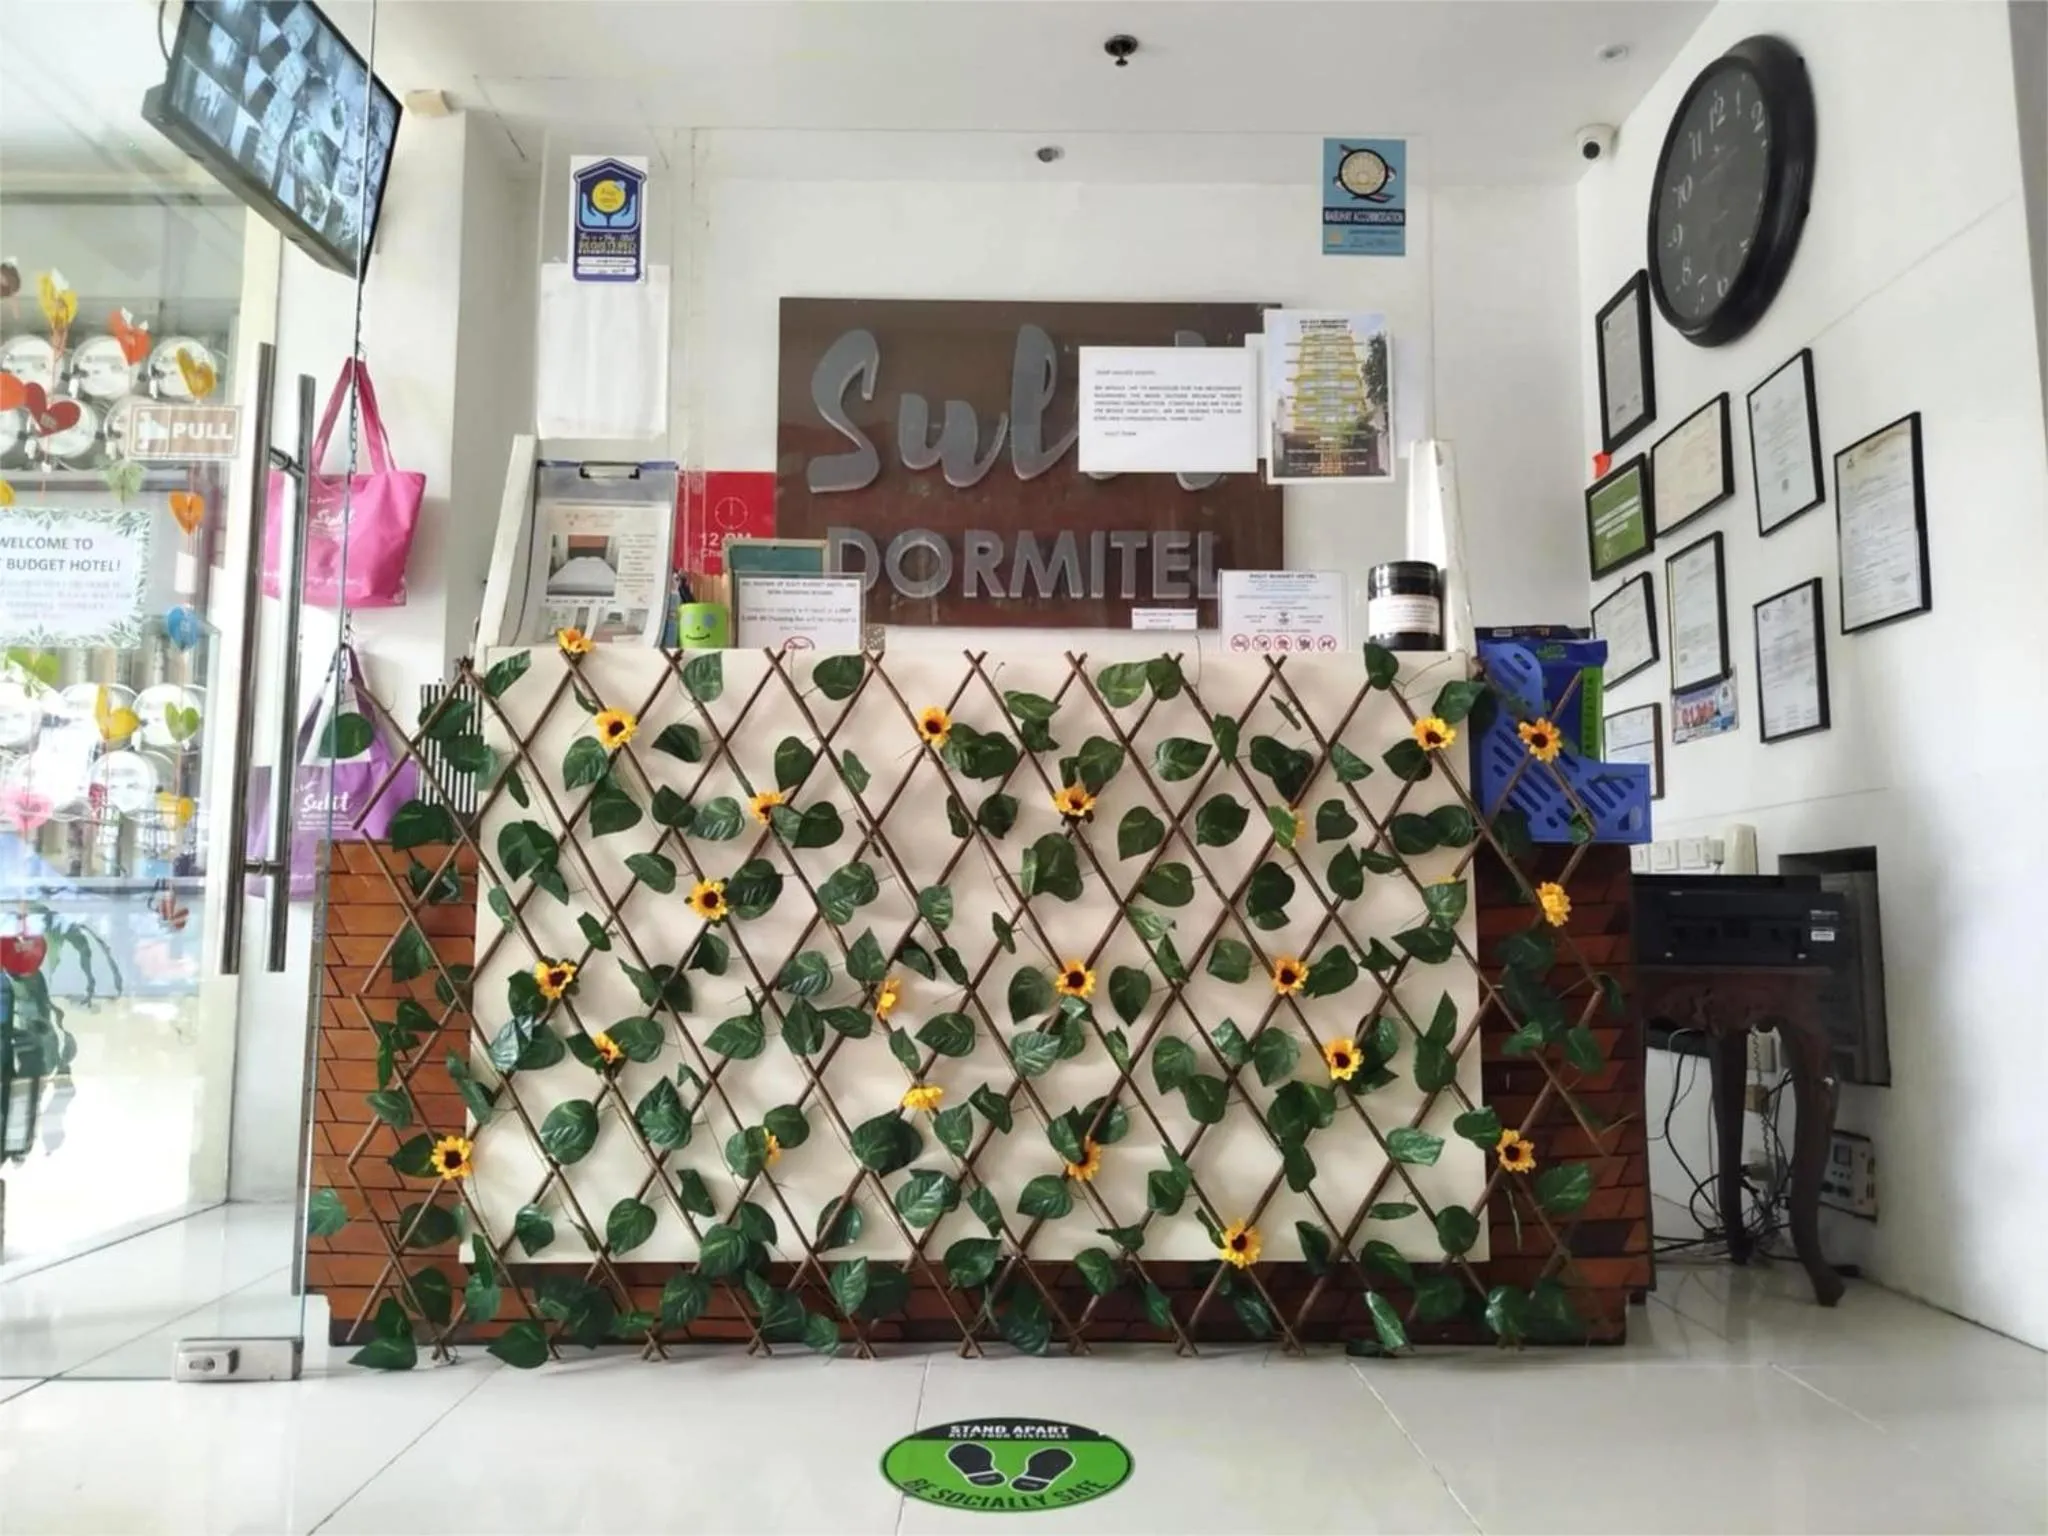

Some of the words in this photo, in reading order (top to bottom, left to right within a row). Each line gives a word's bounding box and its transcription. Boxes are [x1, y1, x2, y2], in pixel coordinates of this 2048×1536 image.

[806, 324, 1226, 493] Sul
[172, 421, 234, 440] PULL
[0, 536, 69, 551] WELCOME
[74, 537, 95, 551] TO
[700, 532, 720, 547] 12
[6, 557, 65, 572] BUDGET
[69, 558, 121, 573] HOTEL!
[827, 526, 1218, 600] DORMITEL
[300, 791, 350, 813] Sulit
[950, 1424, 1007, 1435] STAND
[1012, 1424, 1070, 1435] APART
[904, 1478, 937, 1494] BE
[932, 1489, 1048, 1509] SOCIALLY
